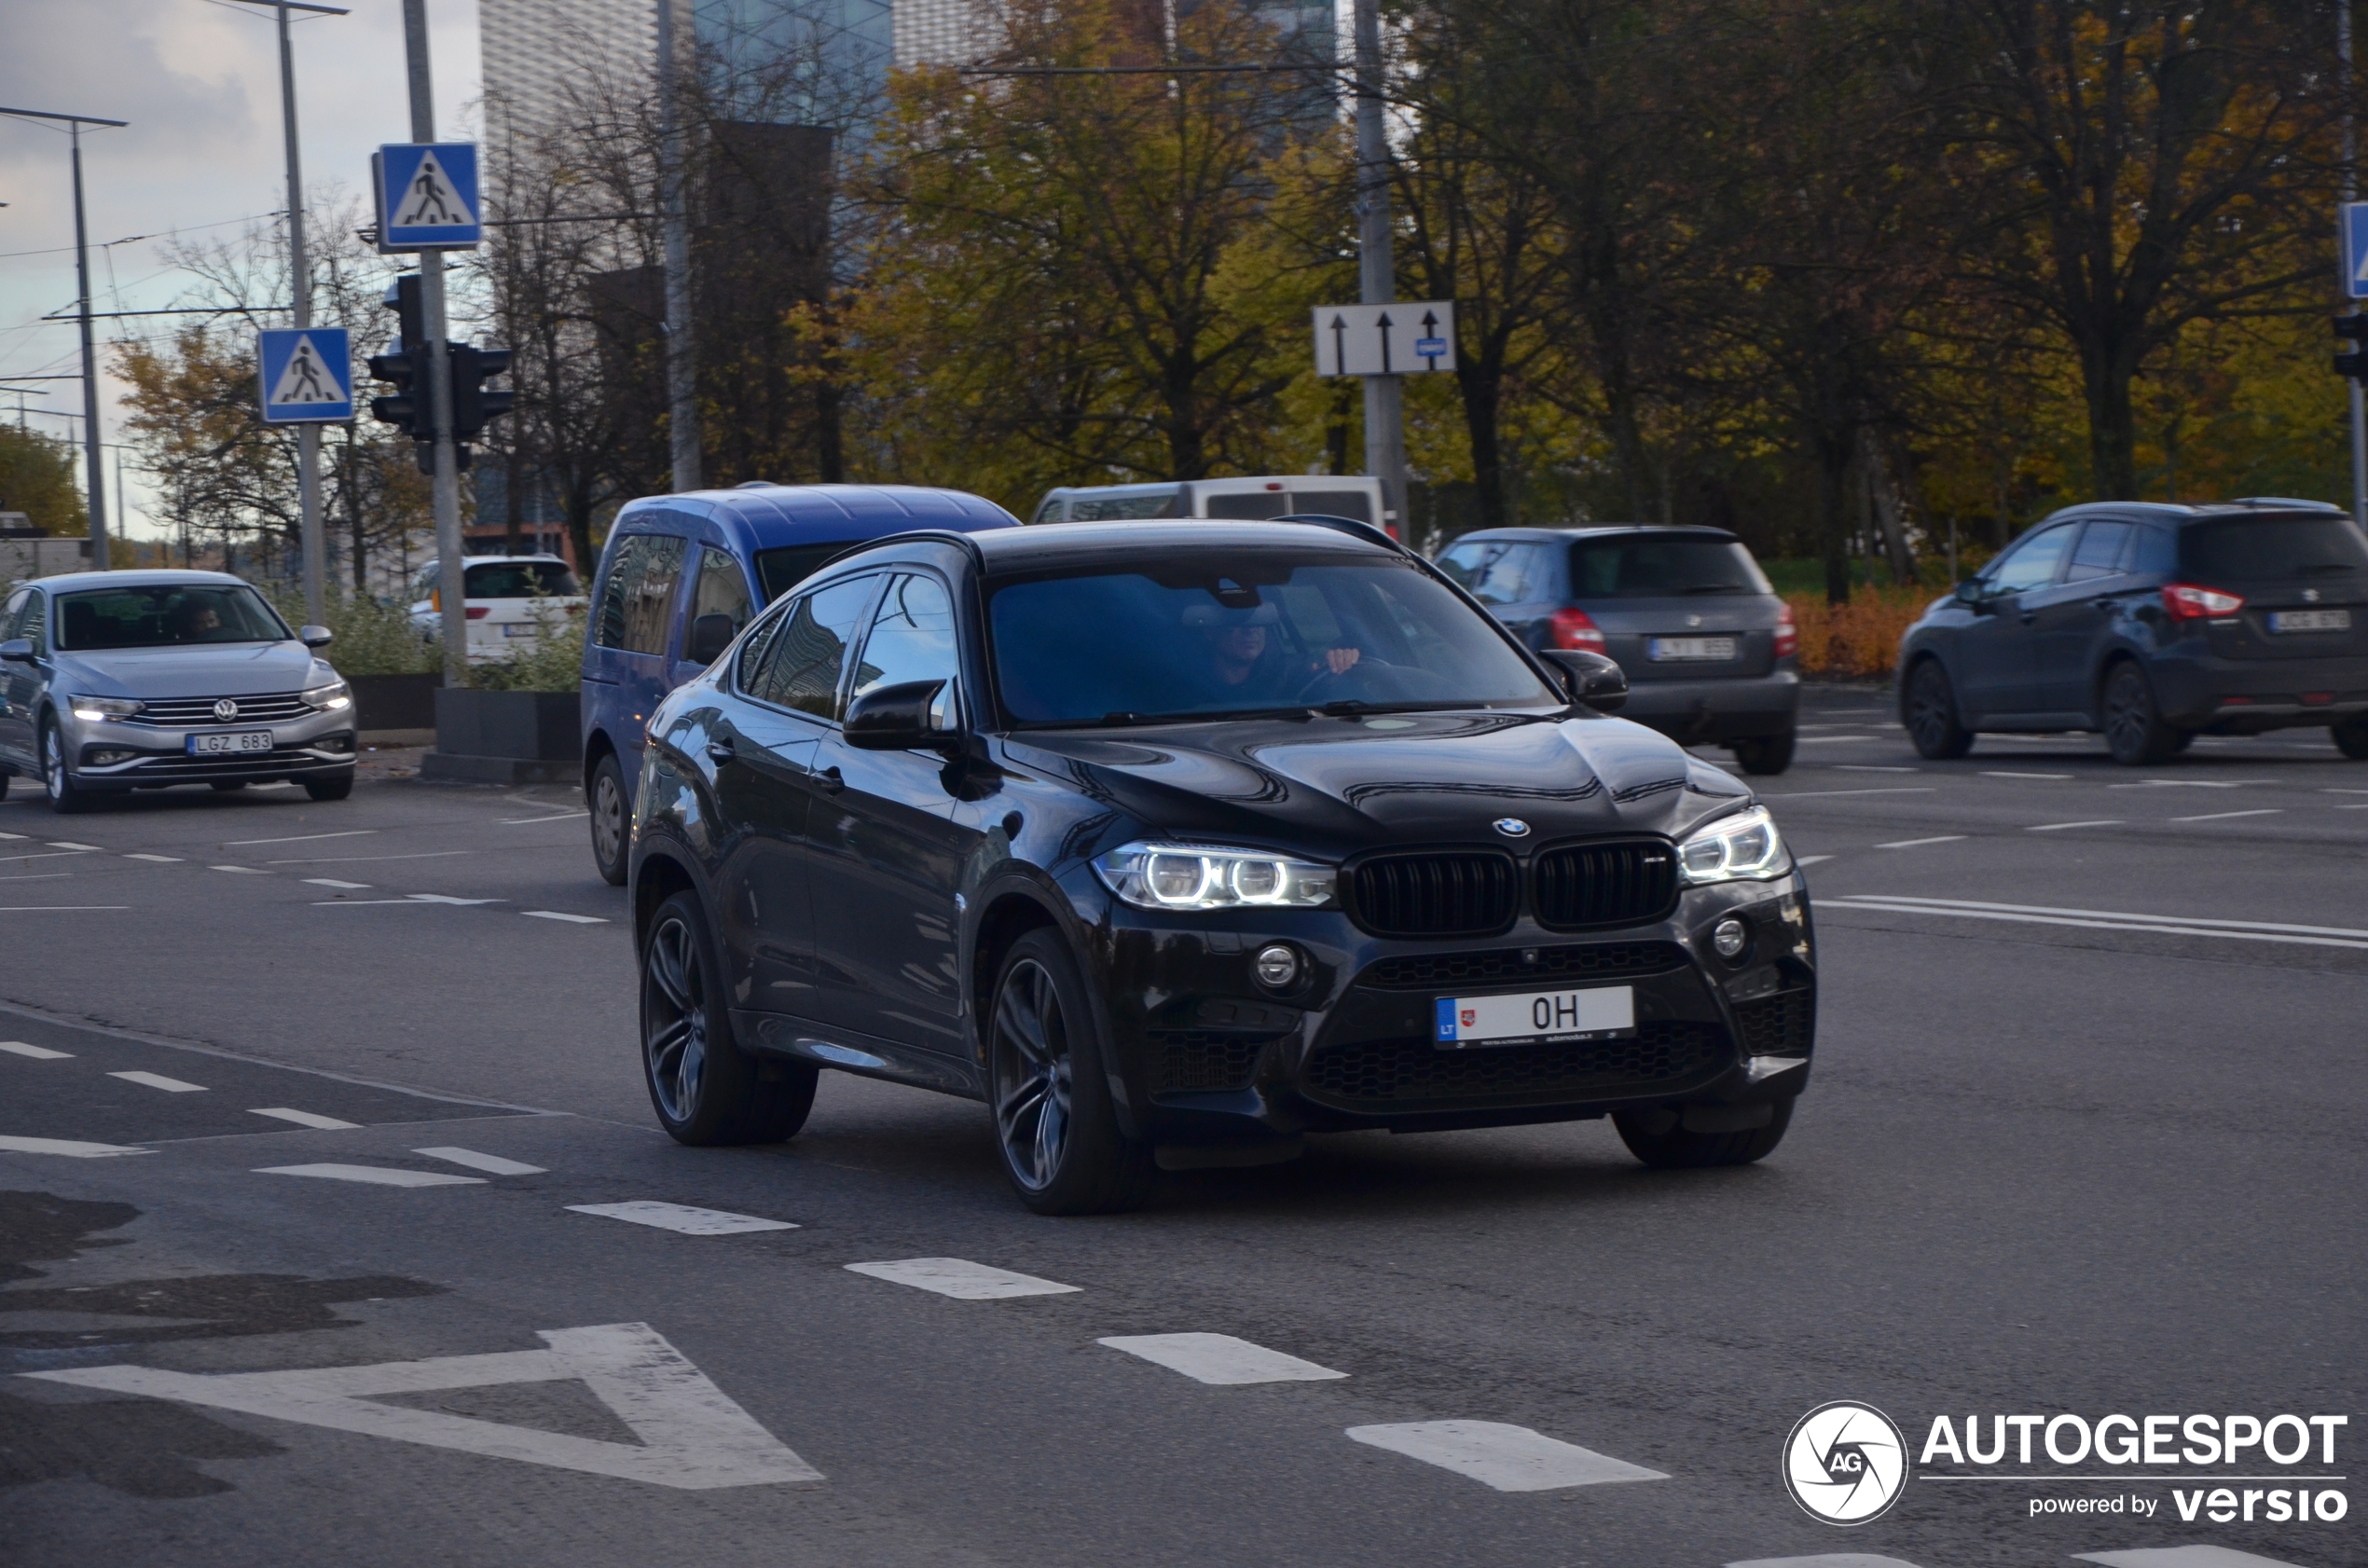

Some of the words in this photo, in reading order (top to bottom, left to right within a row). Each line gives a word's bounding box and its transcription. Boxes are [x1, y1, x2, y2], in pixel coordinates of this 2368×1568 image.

[197, 736, 230, 751] LGZ
[241, 735, 270, 749] 683
[1533, 994, 1578, 1030] OH
[1440, 1024, 1454, 1035] LT
